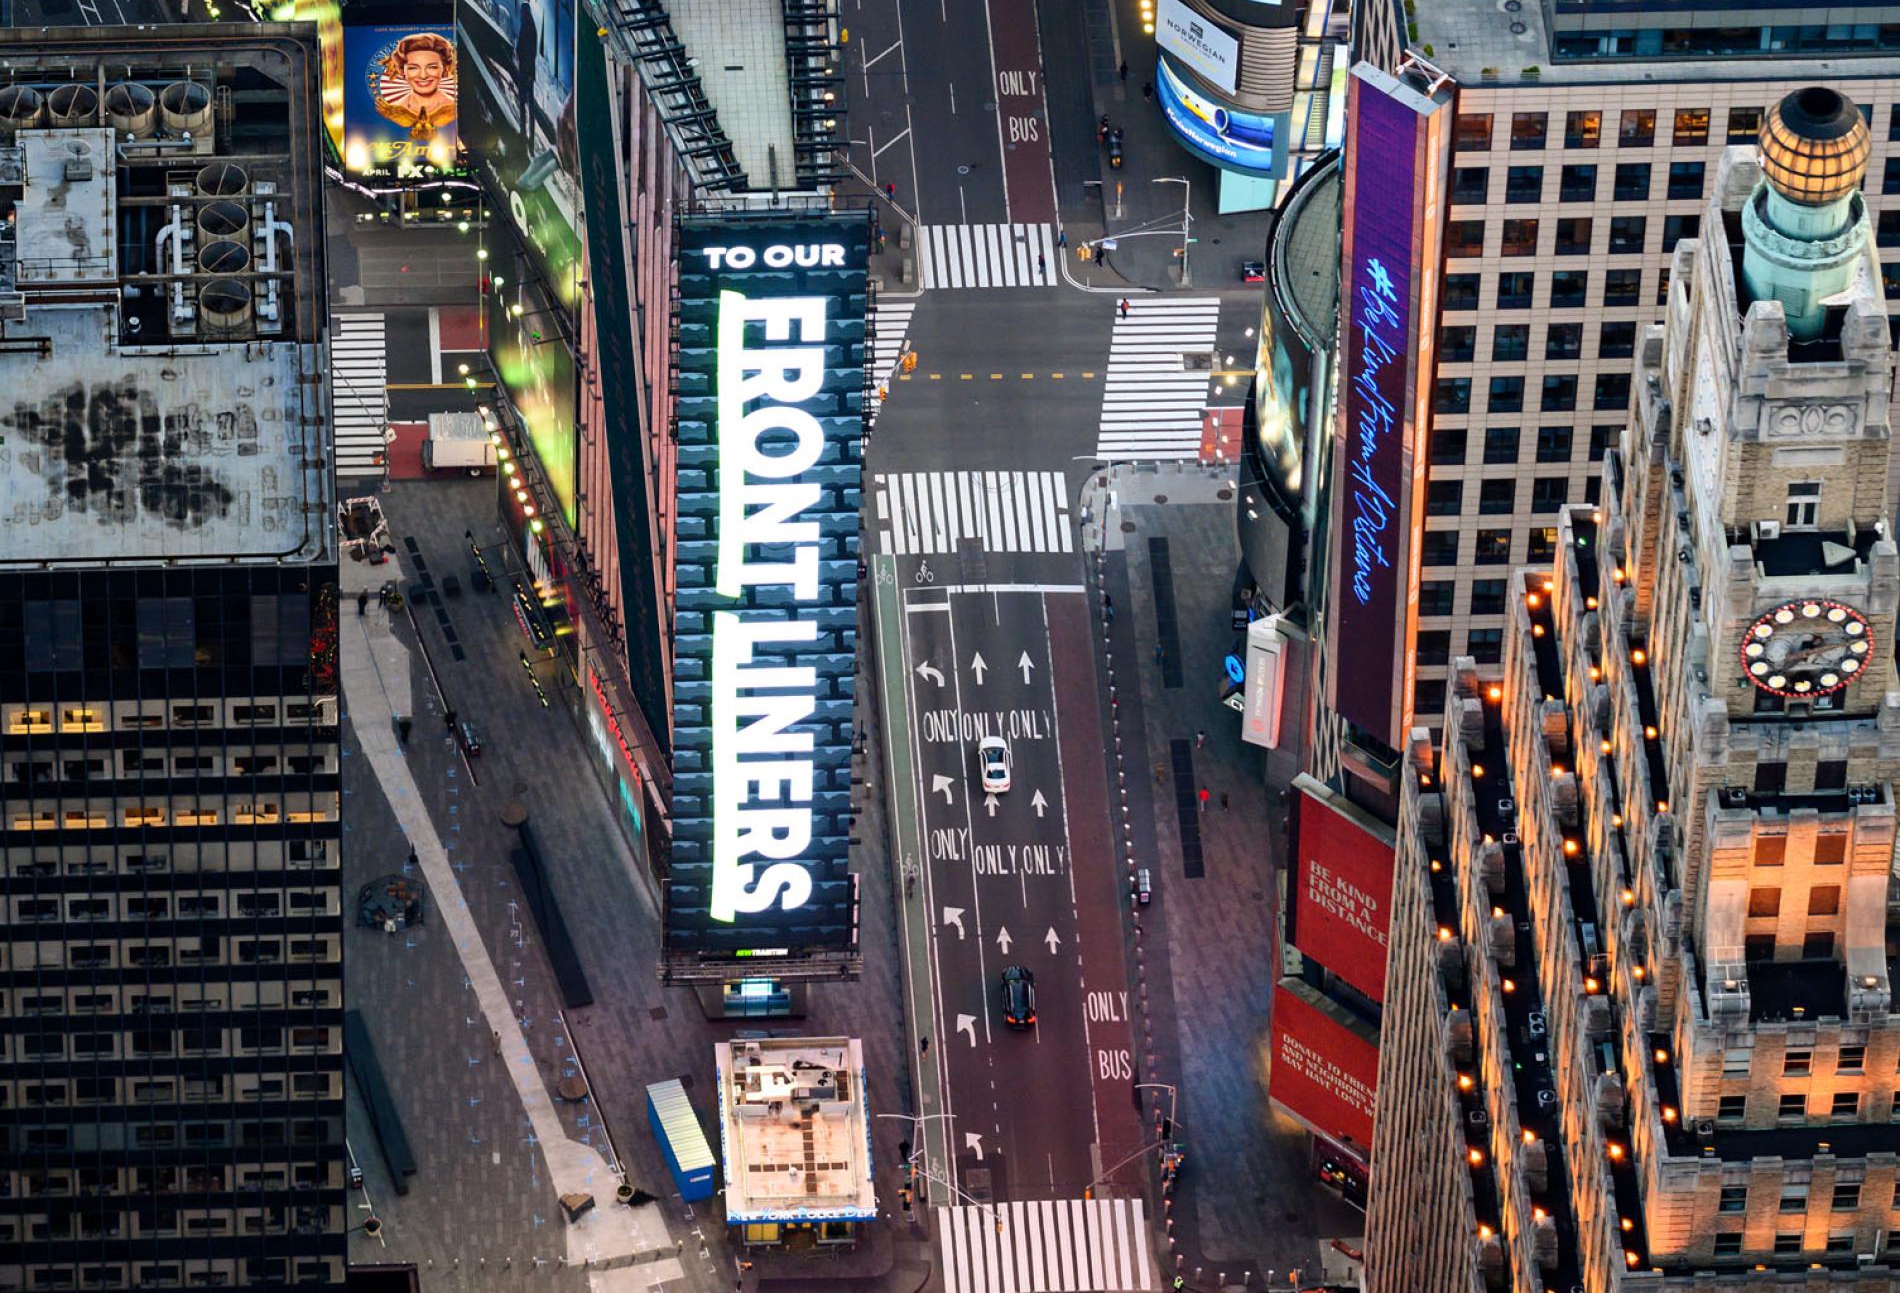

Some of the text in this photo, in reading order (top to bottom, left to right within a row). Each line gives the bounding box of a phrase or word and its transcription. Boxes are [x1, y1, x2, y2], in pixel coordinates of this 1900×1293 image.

[1167, 17, 1226, 64] NORWEGIAN
[999, 70, 1037, 96] ONLY
[1008, 115, 1039, 143] BUS
[362, 168, 392, 177] APRIL
[397, 162, 426, 179] FX
[703, 243, 847, 271] TO OUR
[923, 709, 959, 743] ONLY
[1009, 709, 1051, 740] ONLY
[724, 619, 819, 916] LINERS
[931, 827, 968, 861] ONLY
[975, 844, 1017, 875] ONLY
[1023, 844, 1065, 876] ONLY
[1309, 859, 1378, 912] BE KIND
[1309, 874, 1372, 923] FROM A
[1308, 888, 1388, 948] DISTANCE
[1087, 991, 1128, 1023] ONLY
[1097, 1049, 1132, 1081] BUS
[1282, 1032, 1324, 1066] DONATE
[1326, 1058, 1342, 1077] TO
[1280, 1052, 1362, 1110] MAY HAVE LOST
[1281, 1043, 1368, 1104] AND NEIGHBORS
[843, 1205, 879, 1218] DEPT
